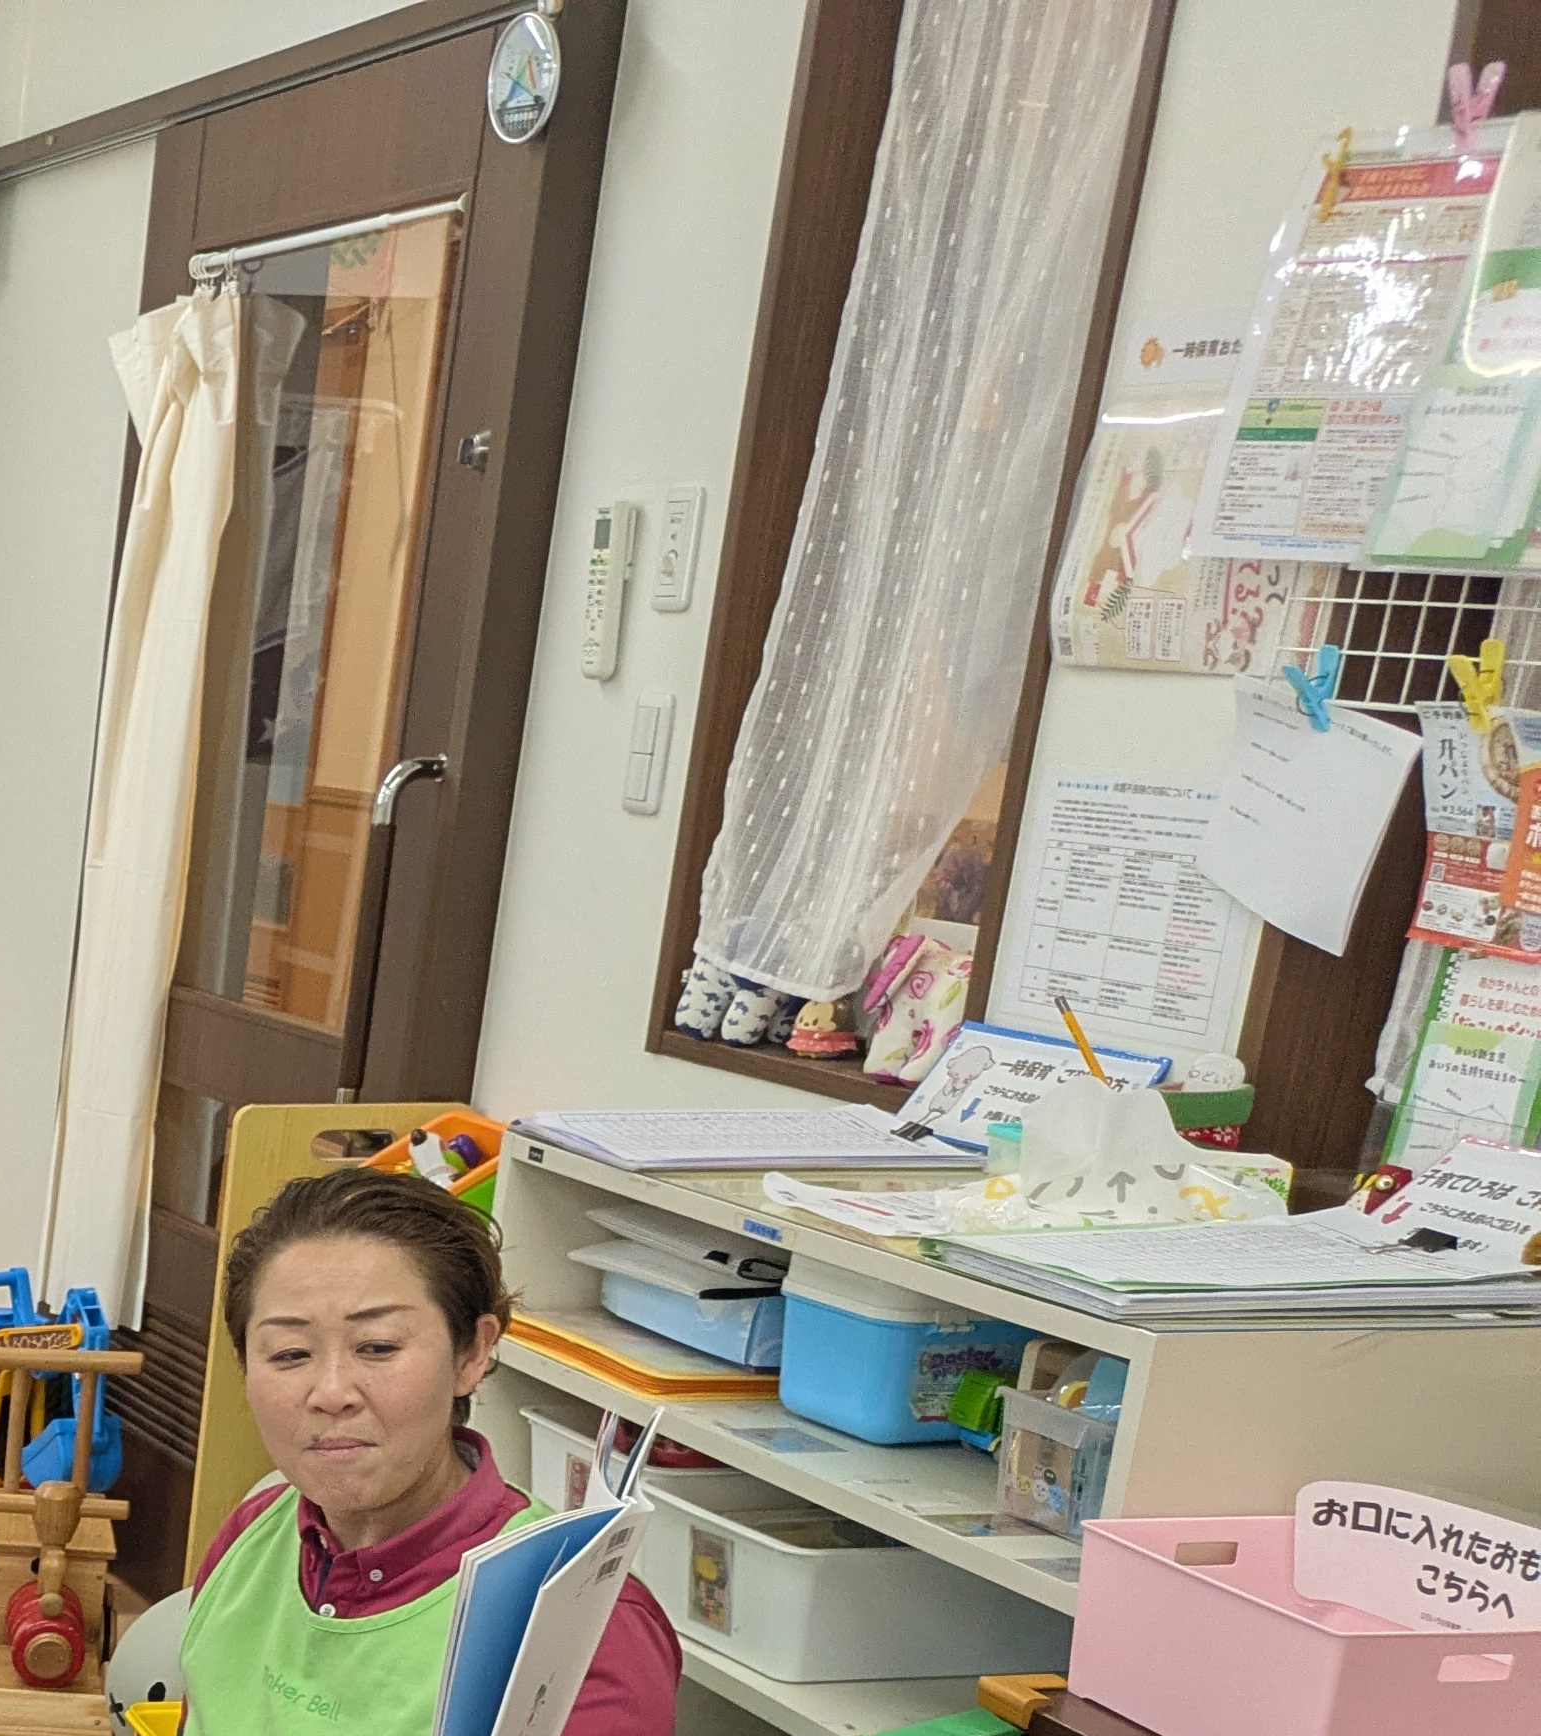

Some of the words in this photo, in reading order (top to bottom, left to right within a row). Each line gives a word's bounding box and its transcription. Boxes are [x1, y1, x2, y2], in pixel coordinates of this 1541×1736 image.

[999, 1059, 1055, 1081] 一時保育
[1417, 1169, 1518, 1200] 子育てひろば
[1416, 1564, 1515, 1619] こちらへ
[306, 1695, 342, 1721] Bell
